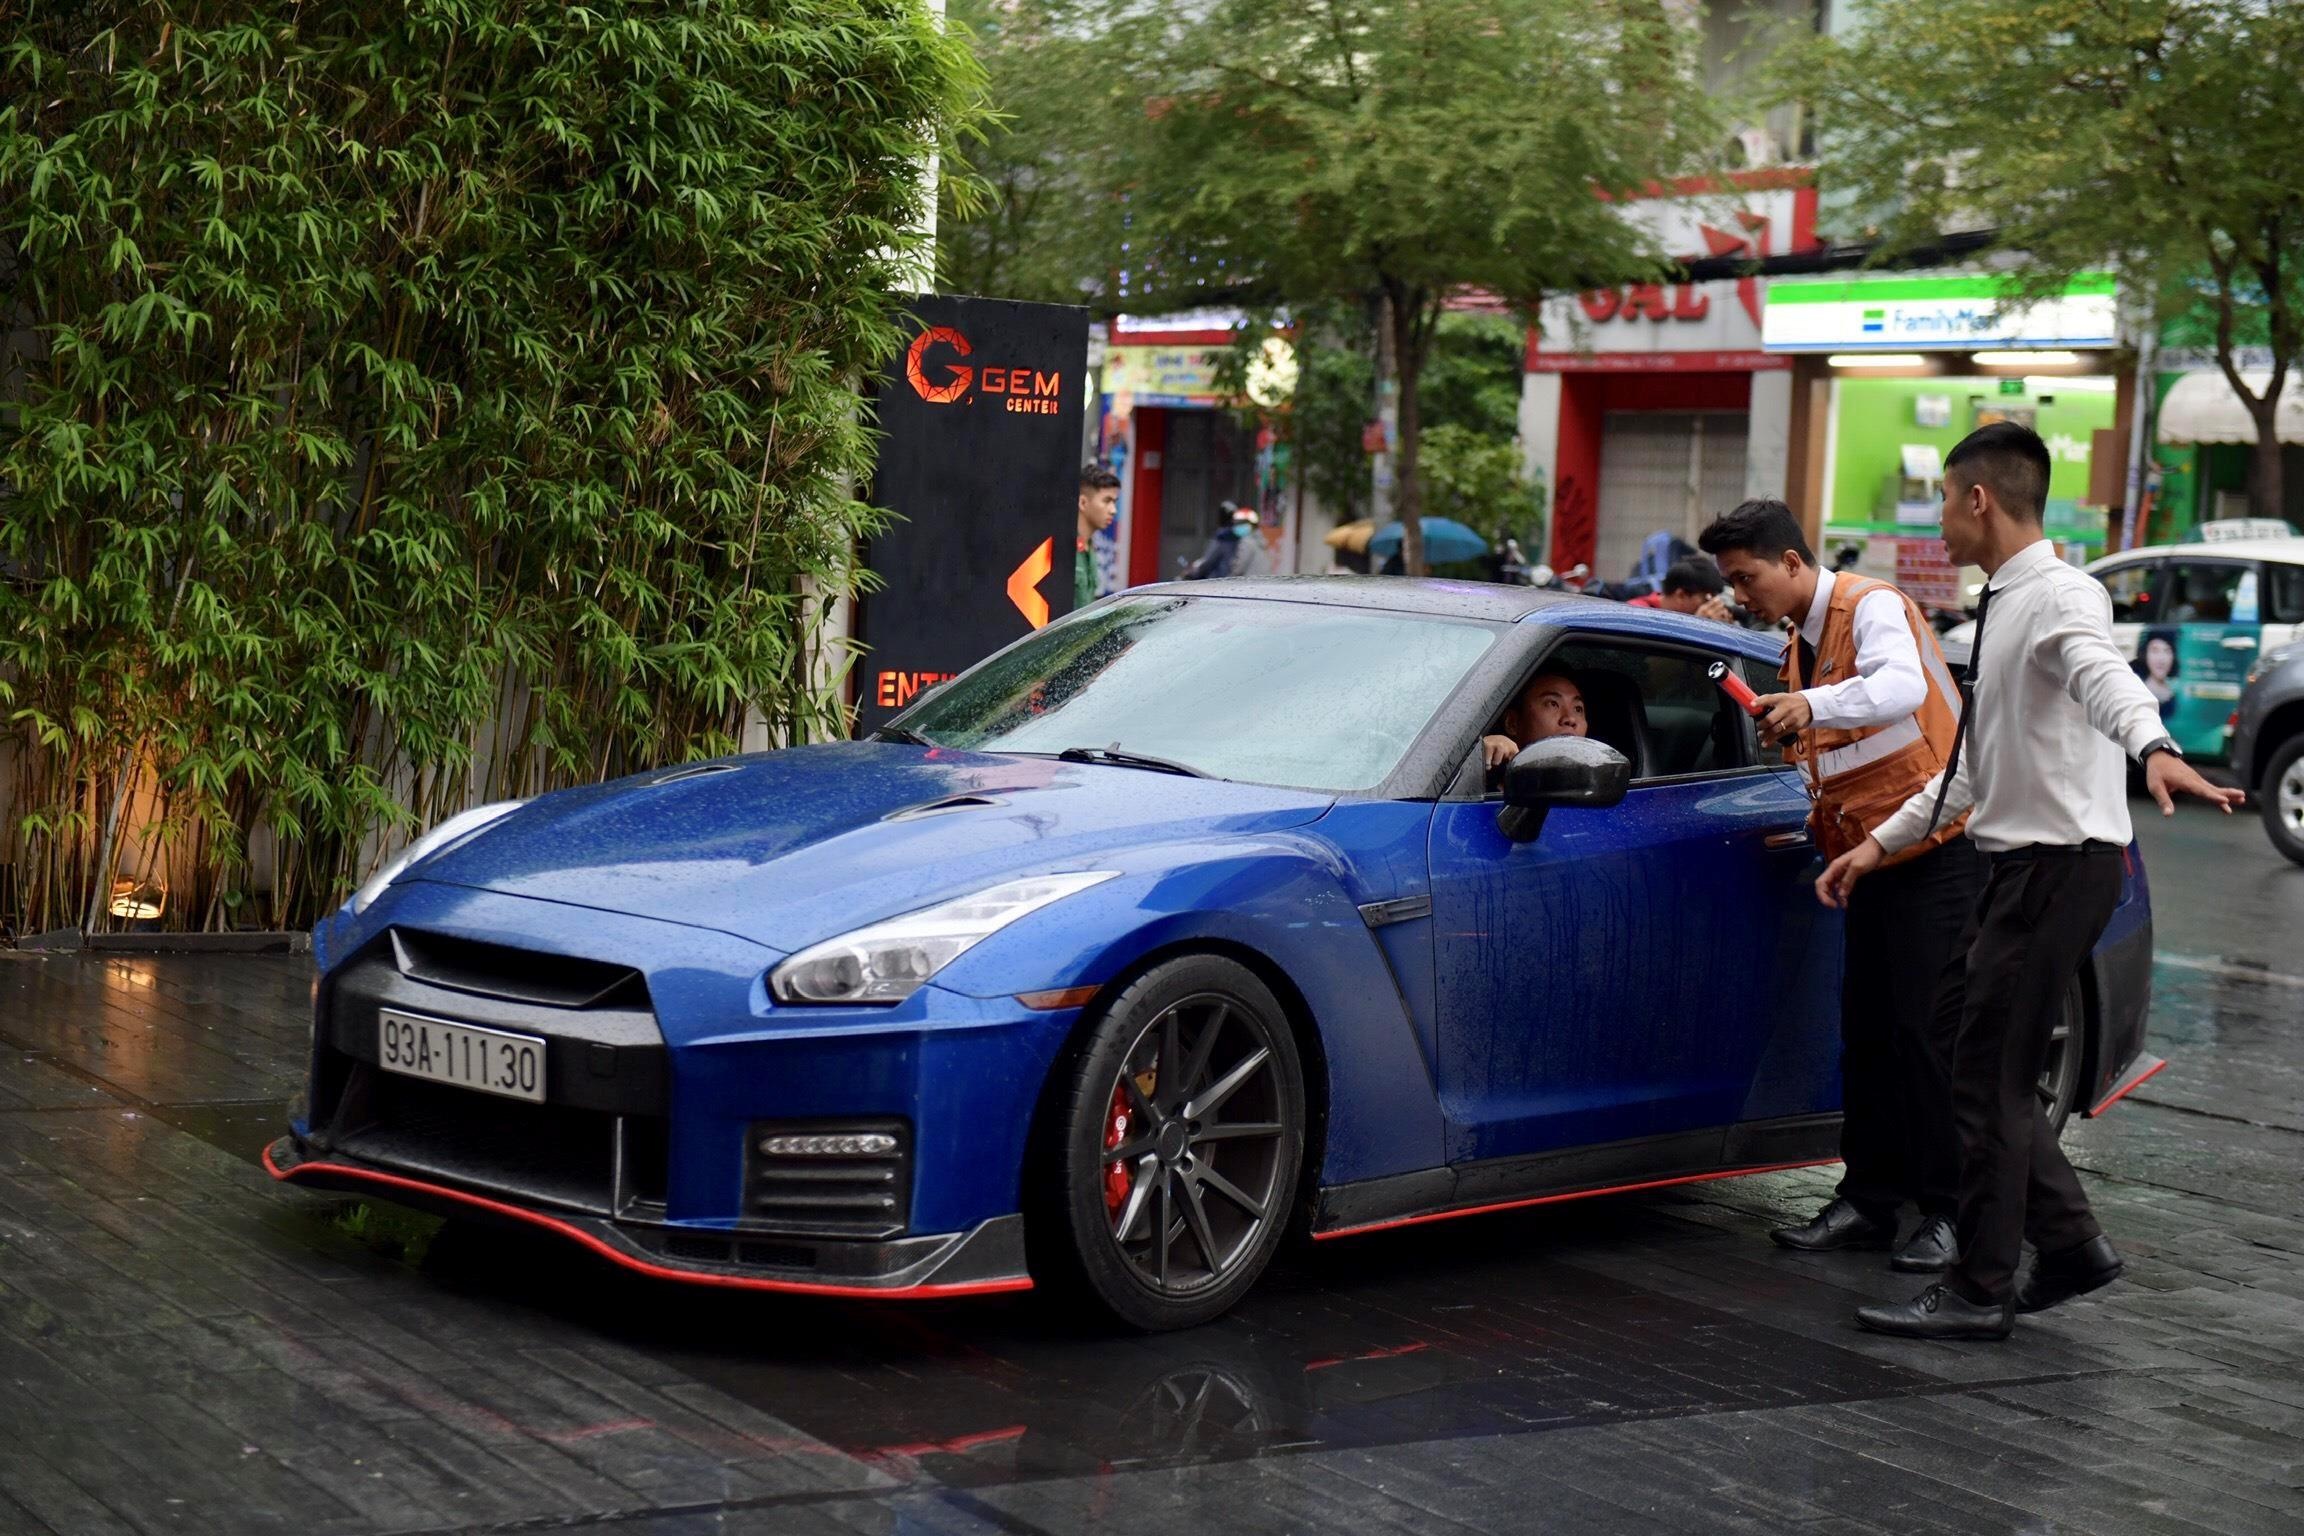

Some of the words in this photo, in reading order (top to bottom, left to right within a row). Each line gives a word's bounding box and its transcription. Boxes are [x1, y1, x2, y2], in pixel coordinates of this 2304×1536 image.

[981, 367, 1060, 397] GEM
[1006, 397, 1059, 415] CENTER
[877, 672, 956, 707] ENT
[385, 1019, 536, 1093] 93A-111.30
